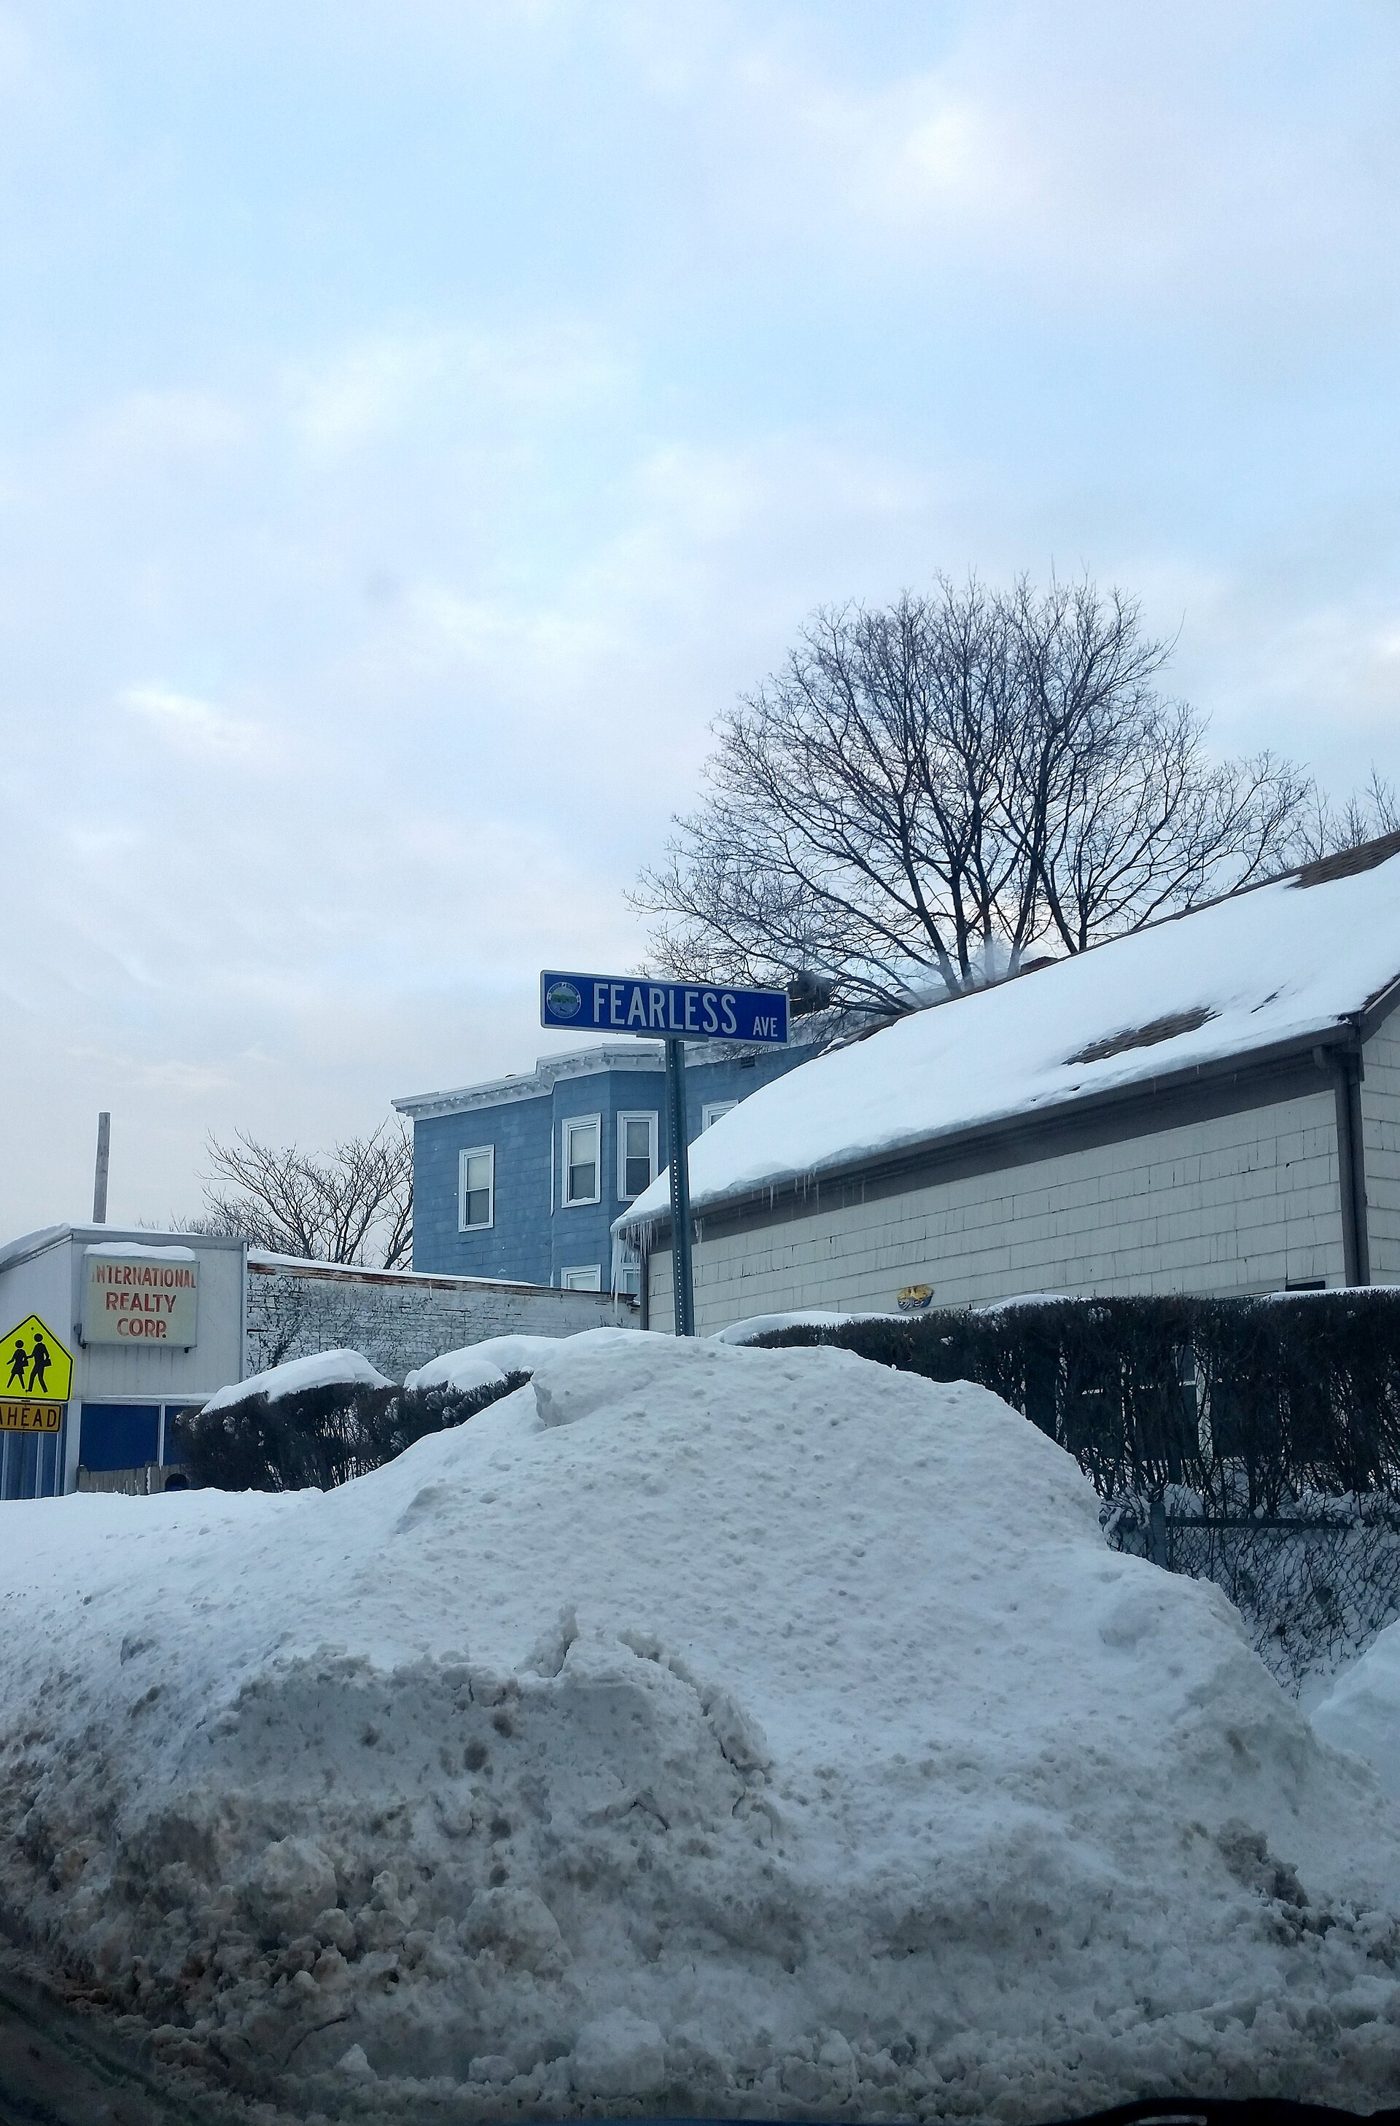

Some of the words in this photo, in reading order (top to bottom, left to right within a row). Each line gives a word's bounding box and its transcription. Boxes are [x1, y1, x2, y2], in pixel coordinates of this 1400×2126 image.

[593, 982, 737, 1034] FEARLESS
[753, 1015, 778, 1037] AVE
[105, 1291, 177, 1313] REALTY
[116, 1317, 167, 1339] CORP.
